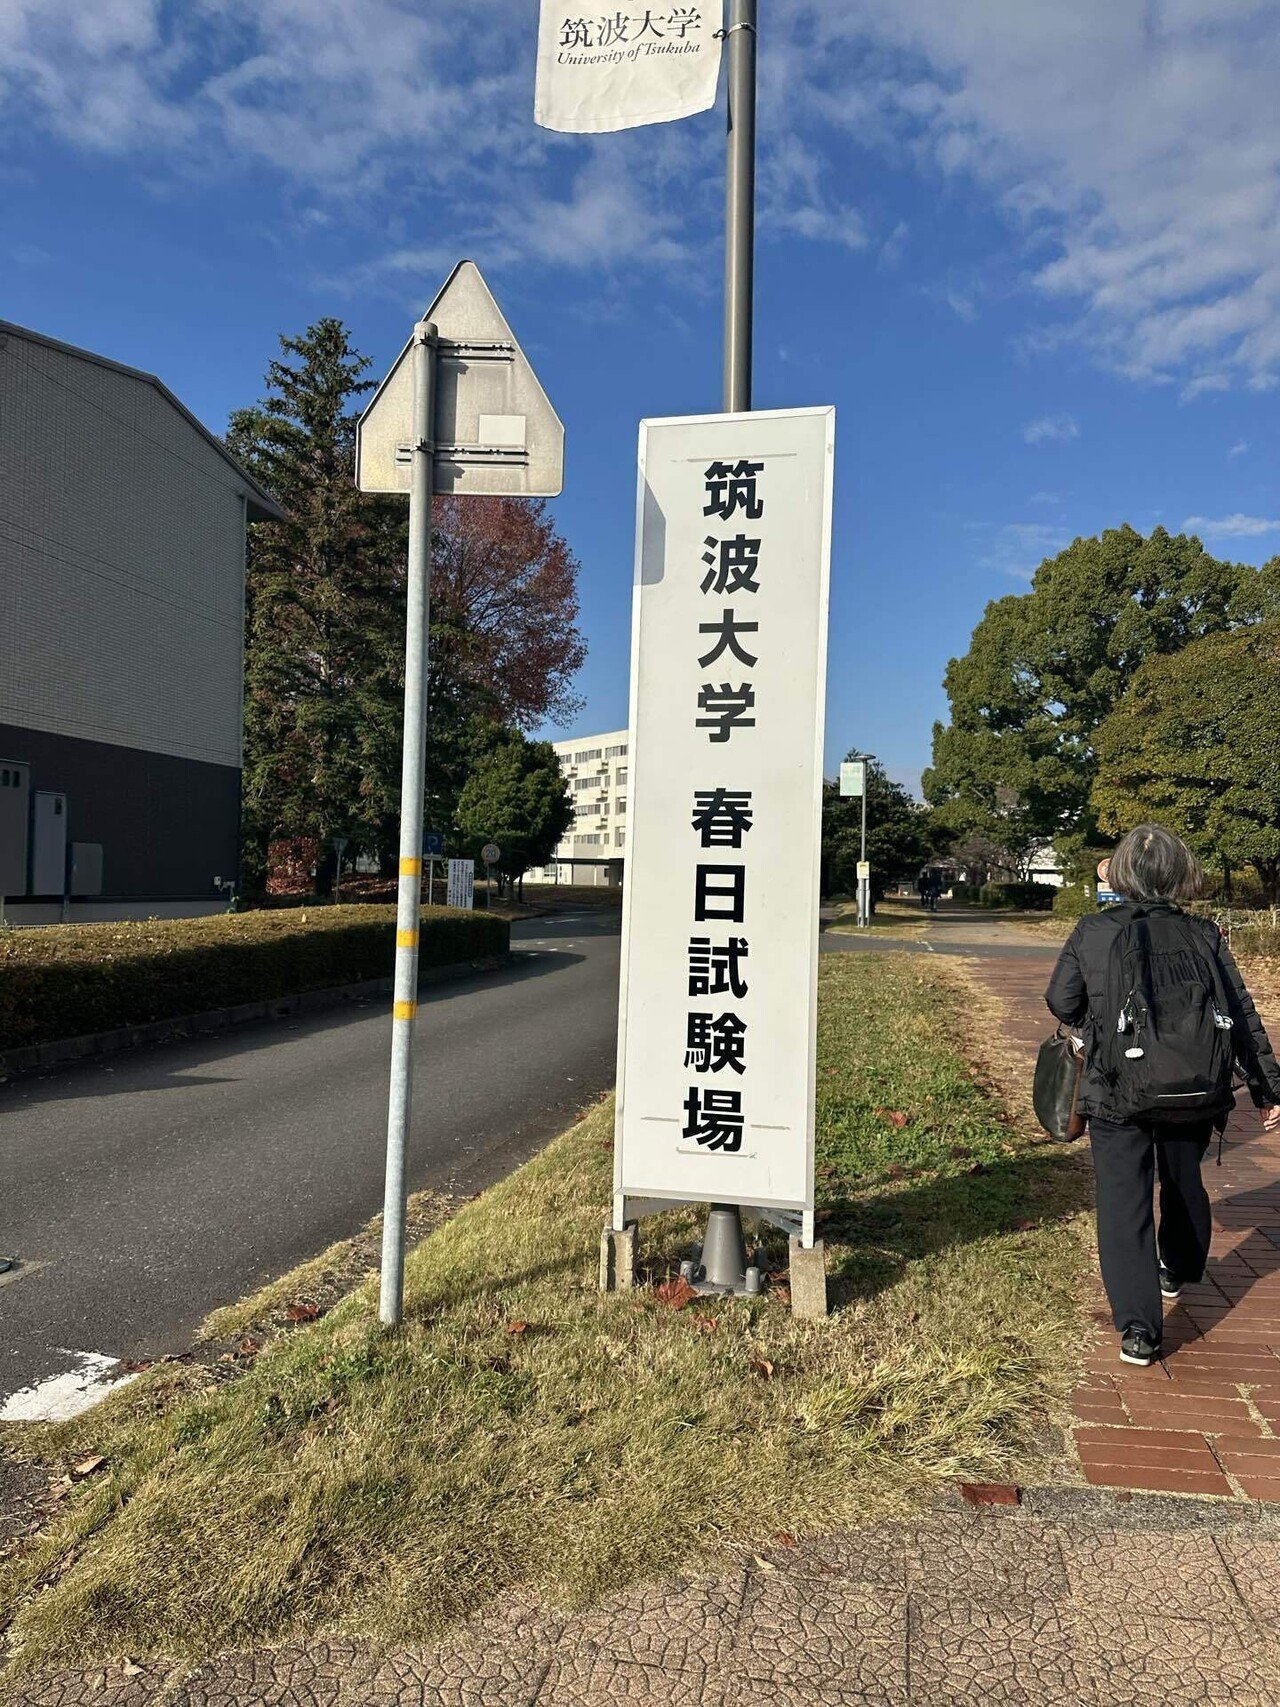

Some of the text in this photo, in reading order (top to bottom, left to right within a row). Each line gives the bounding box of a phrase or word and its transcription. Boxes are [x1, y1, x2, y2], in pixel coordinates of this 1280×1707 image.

[559, 7, 702, 49] 筑波大学
[557, 41, 700, 65] University of Tsukuba
[683, 460, 764, 1152] 筑波大学 春日試験場
